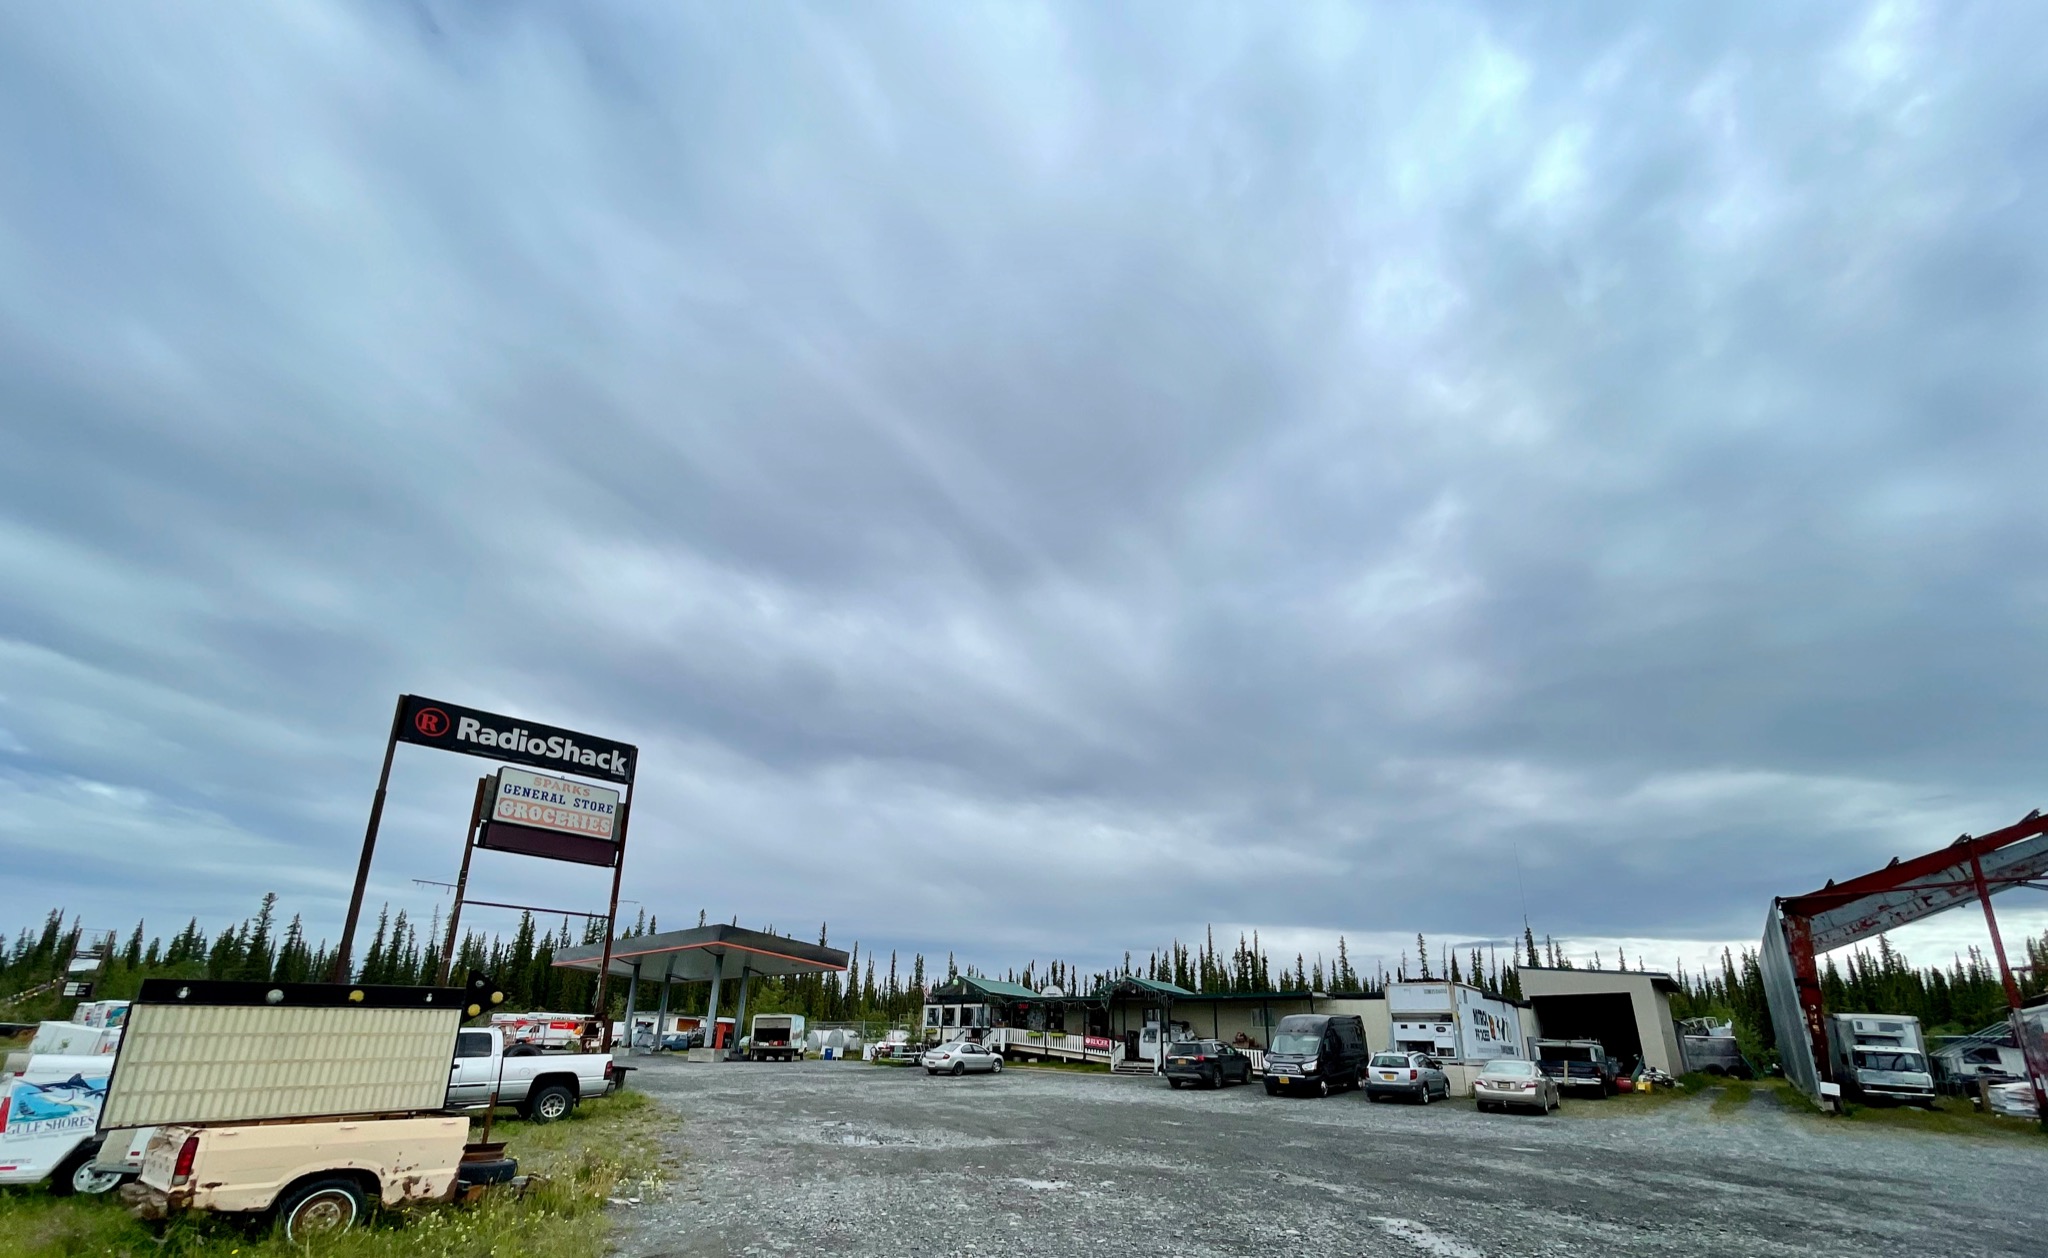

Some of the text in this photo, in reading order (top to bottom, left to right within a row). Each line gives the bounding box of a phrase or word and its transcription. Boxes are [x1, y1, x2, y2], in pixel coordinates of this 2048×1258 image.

[456, 716, 628, 774] RadioShack
[503, 783, 614, 815] GENERAL STORE
[534, 776, 591, 797] SPARKS
[498, 800, 612, 834] GROCERIES
[7, 1115, 95, 1135] GULF SHORES
